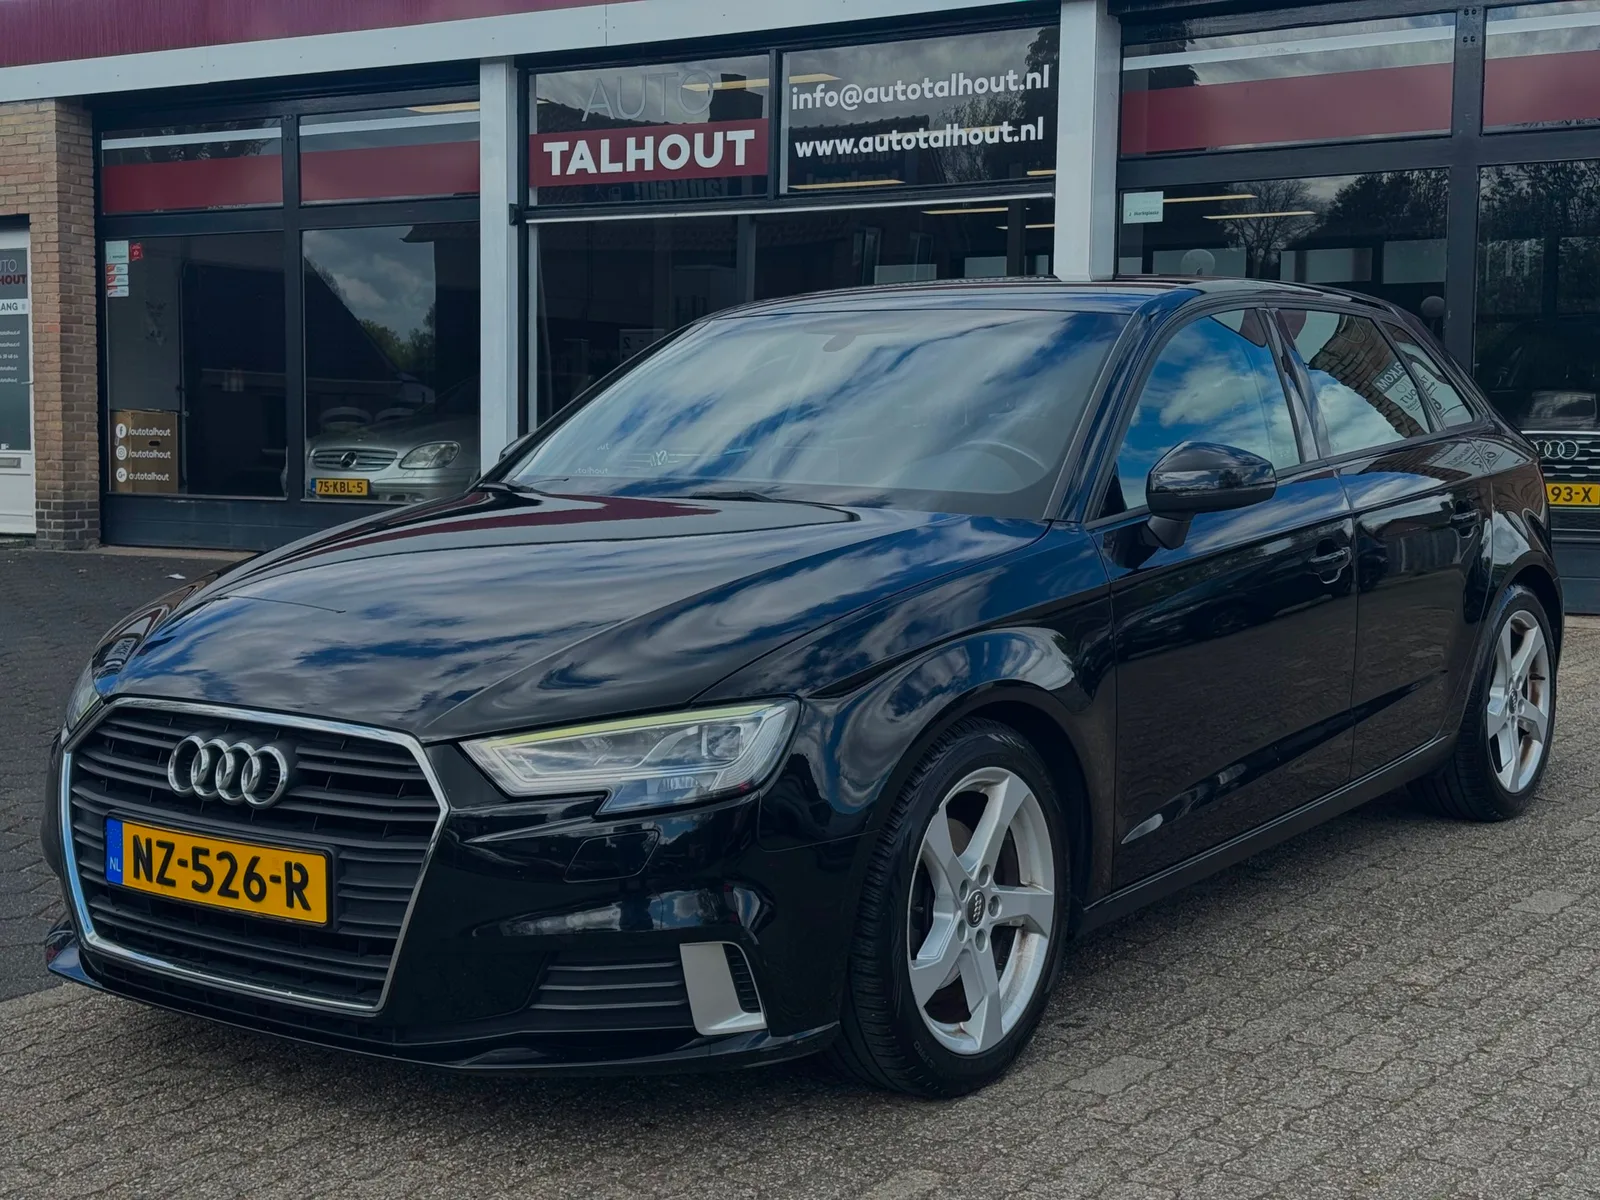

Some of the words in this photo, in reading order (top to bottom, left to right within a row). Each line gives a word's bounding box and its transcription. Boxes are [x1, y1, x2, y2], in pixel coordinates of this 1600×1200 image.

[581, 68, 714, 122] AUTO
[792, 64, 1049, 111] info@autotalhout.nl
[543, 129, 755, 176] TALHOUT
[795, 116, 1044, 158] www.autotalhout.nl
[0, 259, 17, 273] TO
[318, 481, 363, 494] 75-KBL-5
[1551, 486, 1592, 503] 93-X
[109, 857, 121, 872] NL
[132, 834, 311, 911] NZ-526-R
